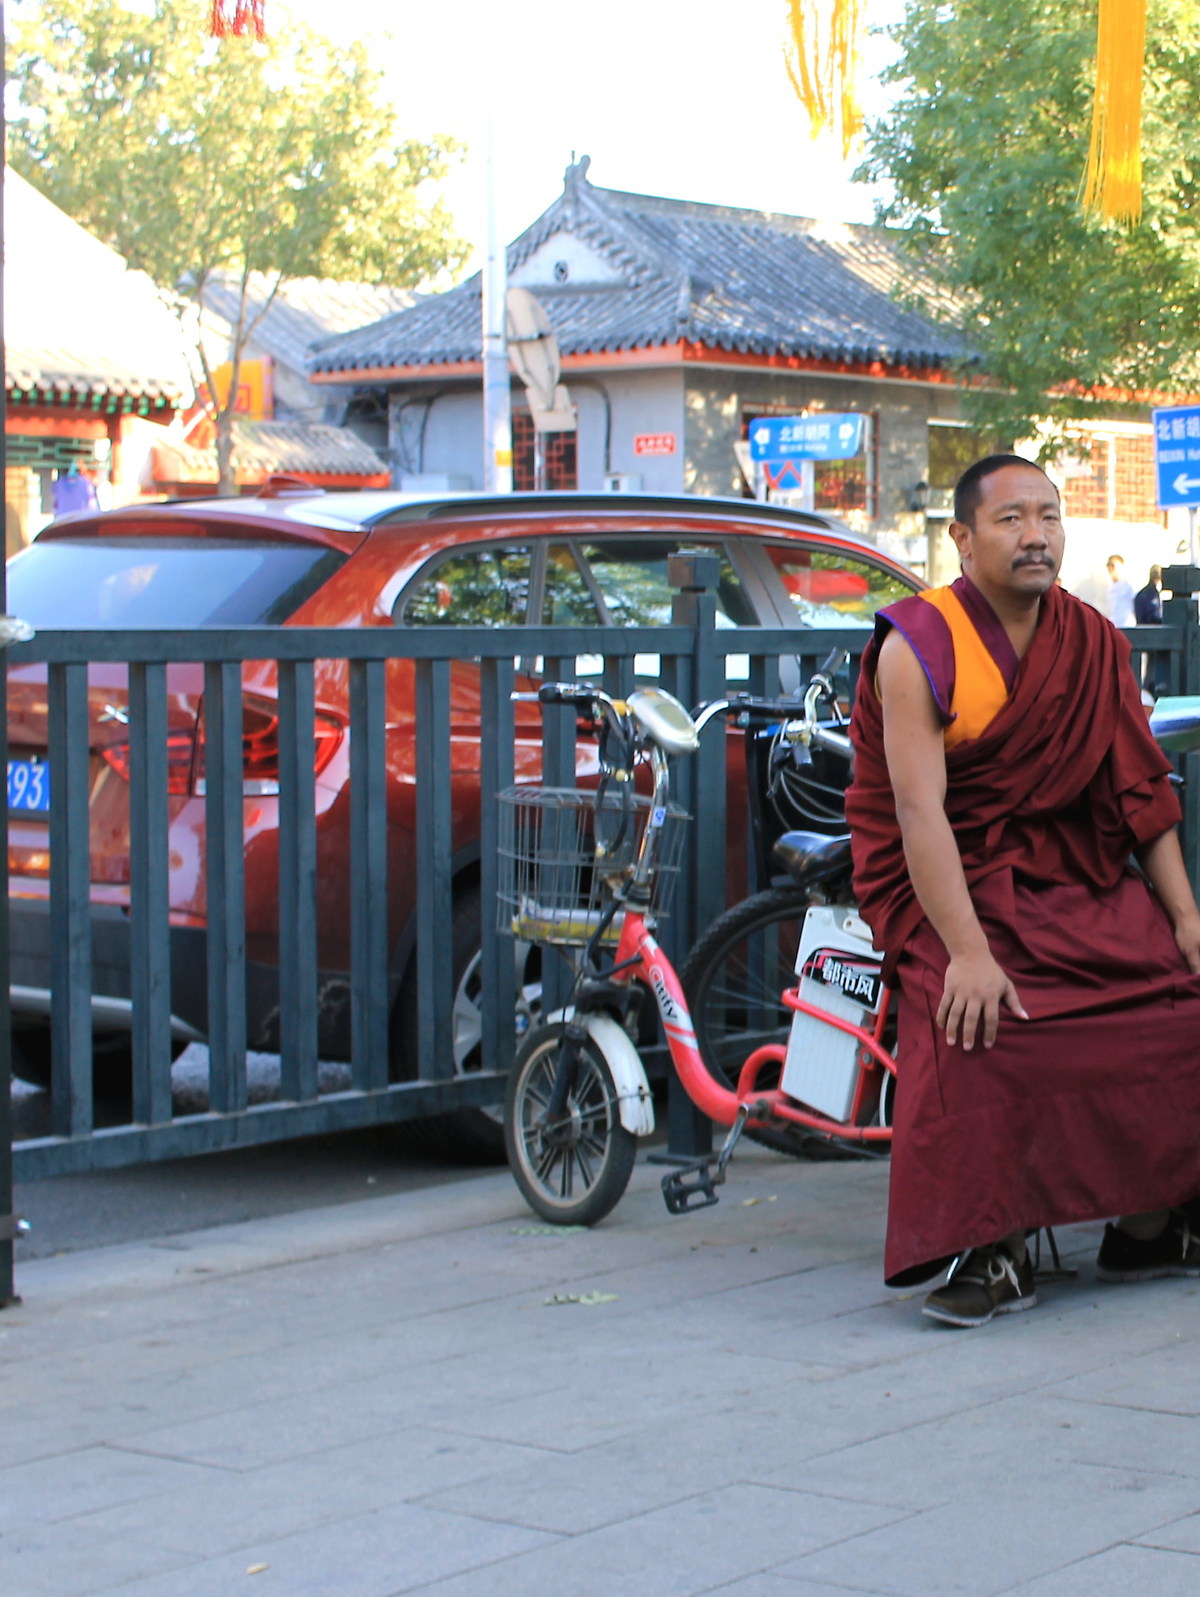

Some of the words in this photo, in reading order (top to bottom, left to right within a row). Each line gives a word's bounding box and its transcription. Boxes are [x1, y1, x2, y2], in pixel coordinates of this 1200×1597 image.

[779, 424, 831, 443] 北新胡同
[7, 762, 49, 811] 93
[822, 957, 875, 1003] 都市风
